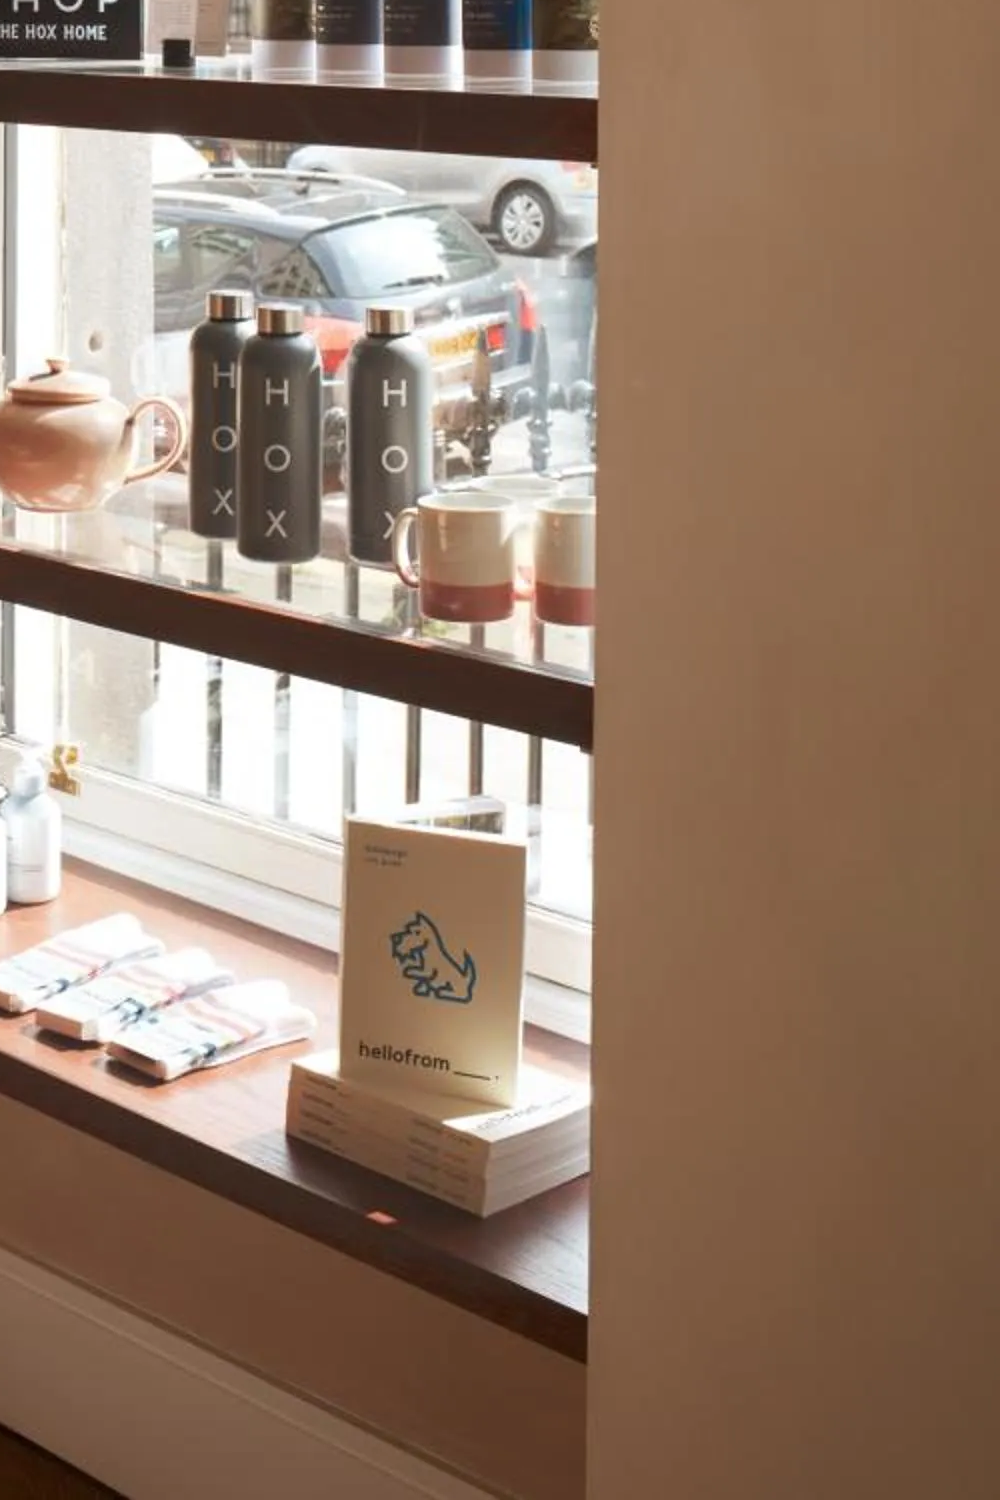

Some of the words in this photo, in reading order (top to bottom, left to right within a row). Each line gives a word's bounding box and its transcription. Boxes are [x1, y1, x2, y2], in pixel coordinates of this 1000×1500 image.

[25, 24, 57, 40] HOX
[63, 24, 108, 41] HOME
[212, 361, 237, 517] HOX
[264, 377, 291, 538] HOX
[359, 1040, 450, 1071] hellofrom
